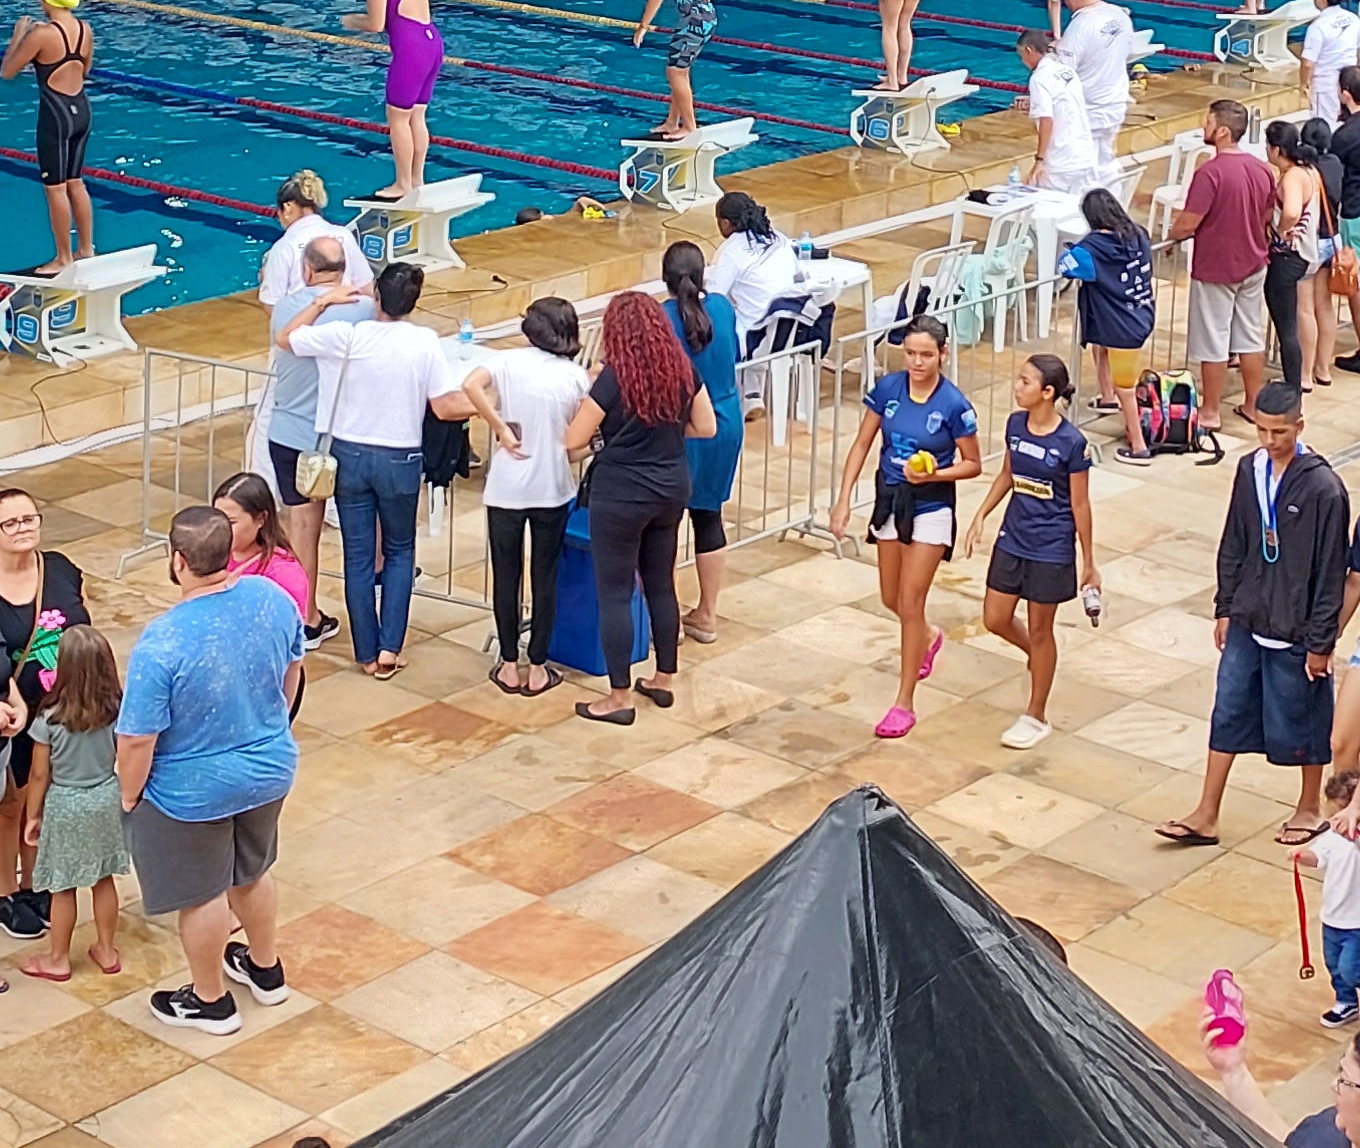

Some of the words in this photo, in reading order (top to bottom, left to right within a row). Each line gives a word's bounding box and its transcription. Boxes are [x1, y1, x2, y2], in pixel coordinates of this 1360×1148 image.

[1231, 38, 1252, 57] 4
[868, 118, 890, 141] 6
[639, 170, 661, 194] 7
[362, 234, 385, 262] 8
[16, 313, 40, 344] 9
